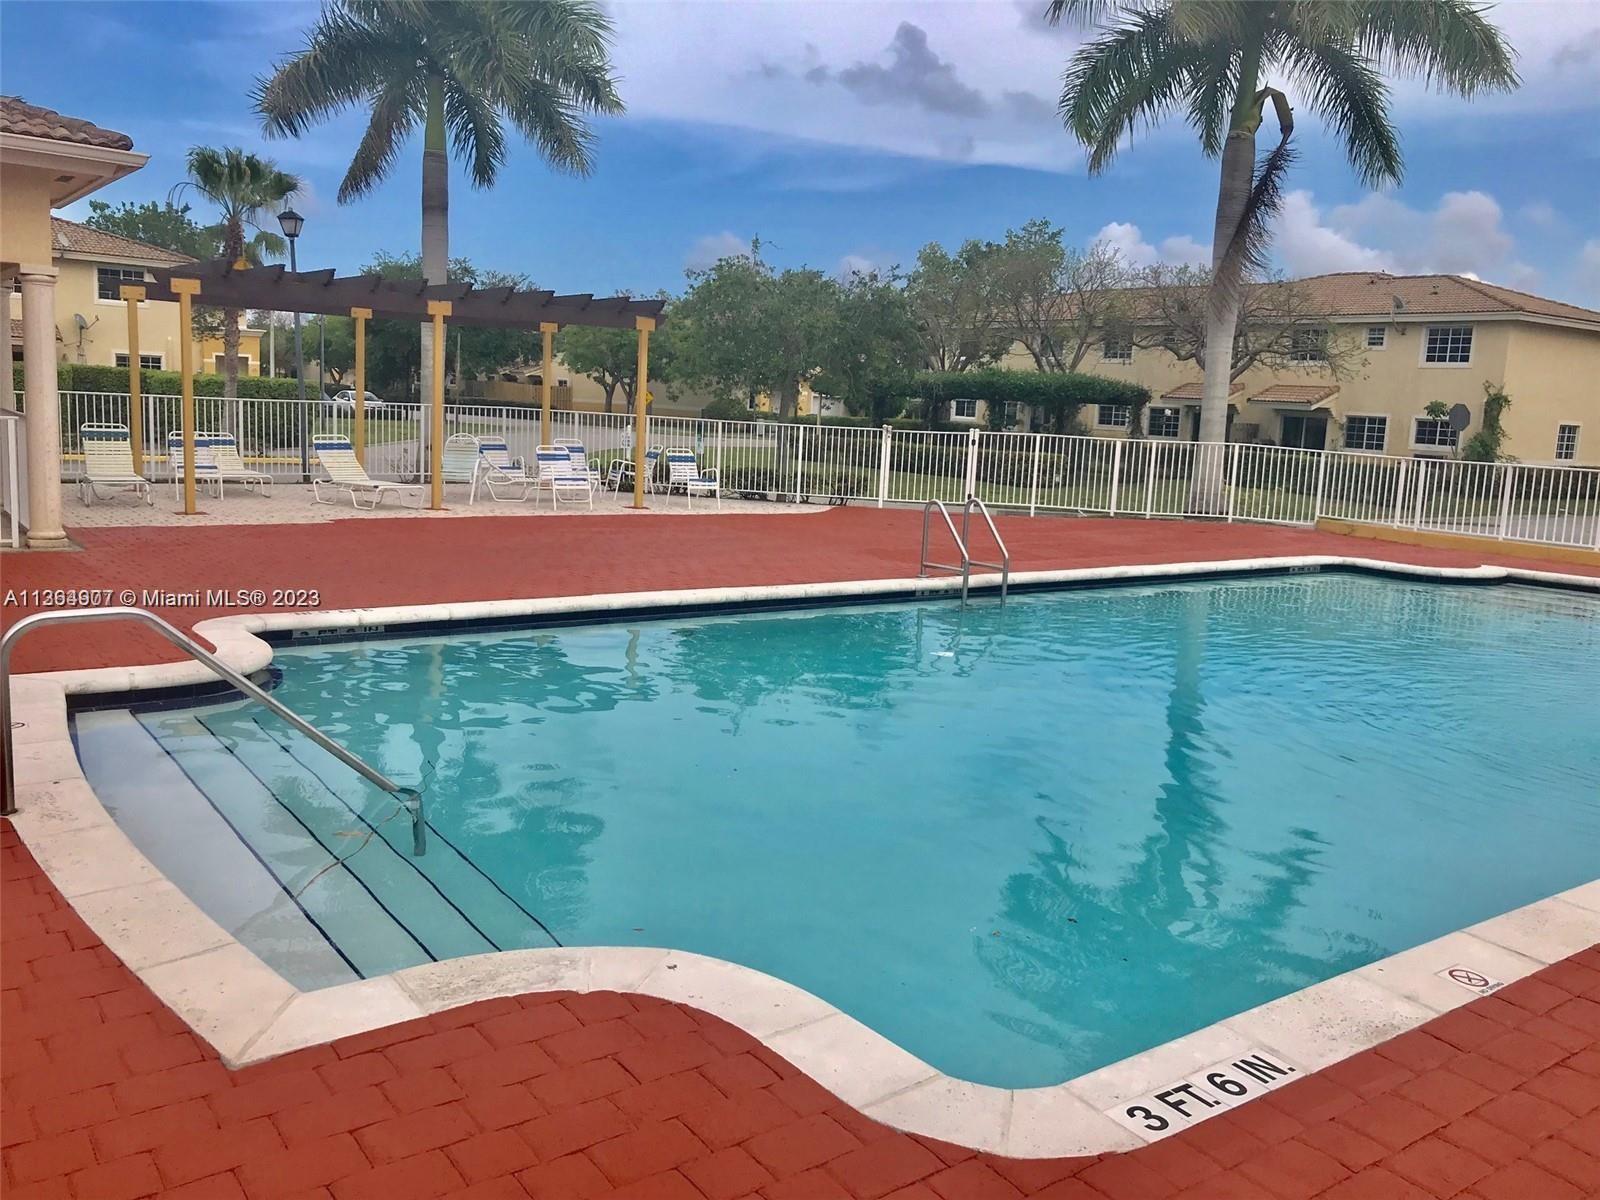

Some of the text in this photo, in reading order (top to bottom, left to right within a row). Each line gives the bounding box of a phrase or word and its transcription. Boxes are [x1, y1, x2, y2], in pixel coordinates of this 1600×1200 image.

[1126, 1054, 1296, 1132] 3 FT. 6 IN.
